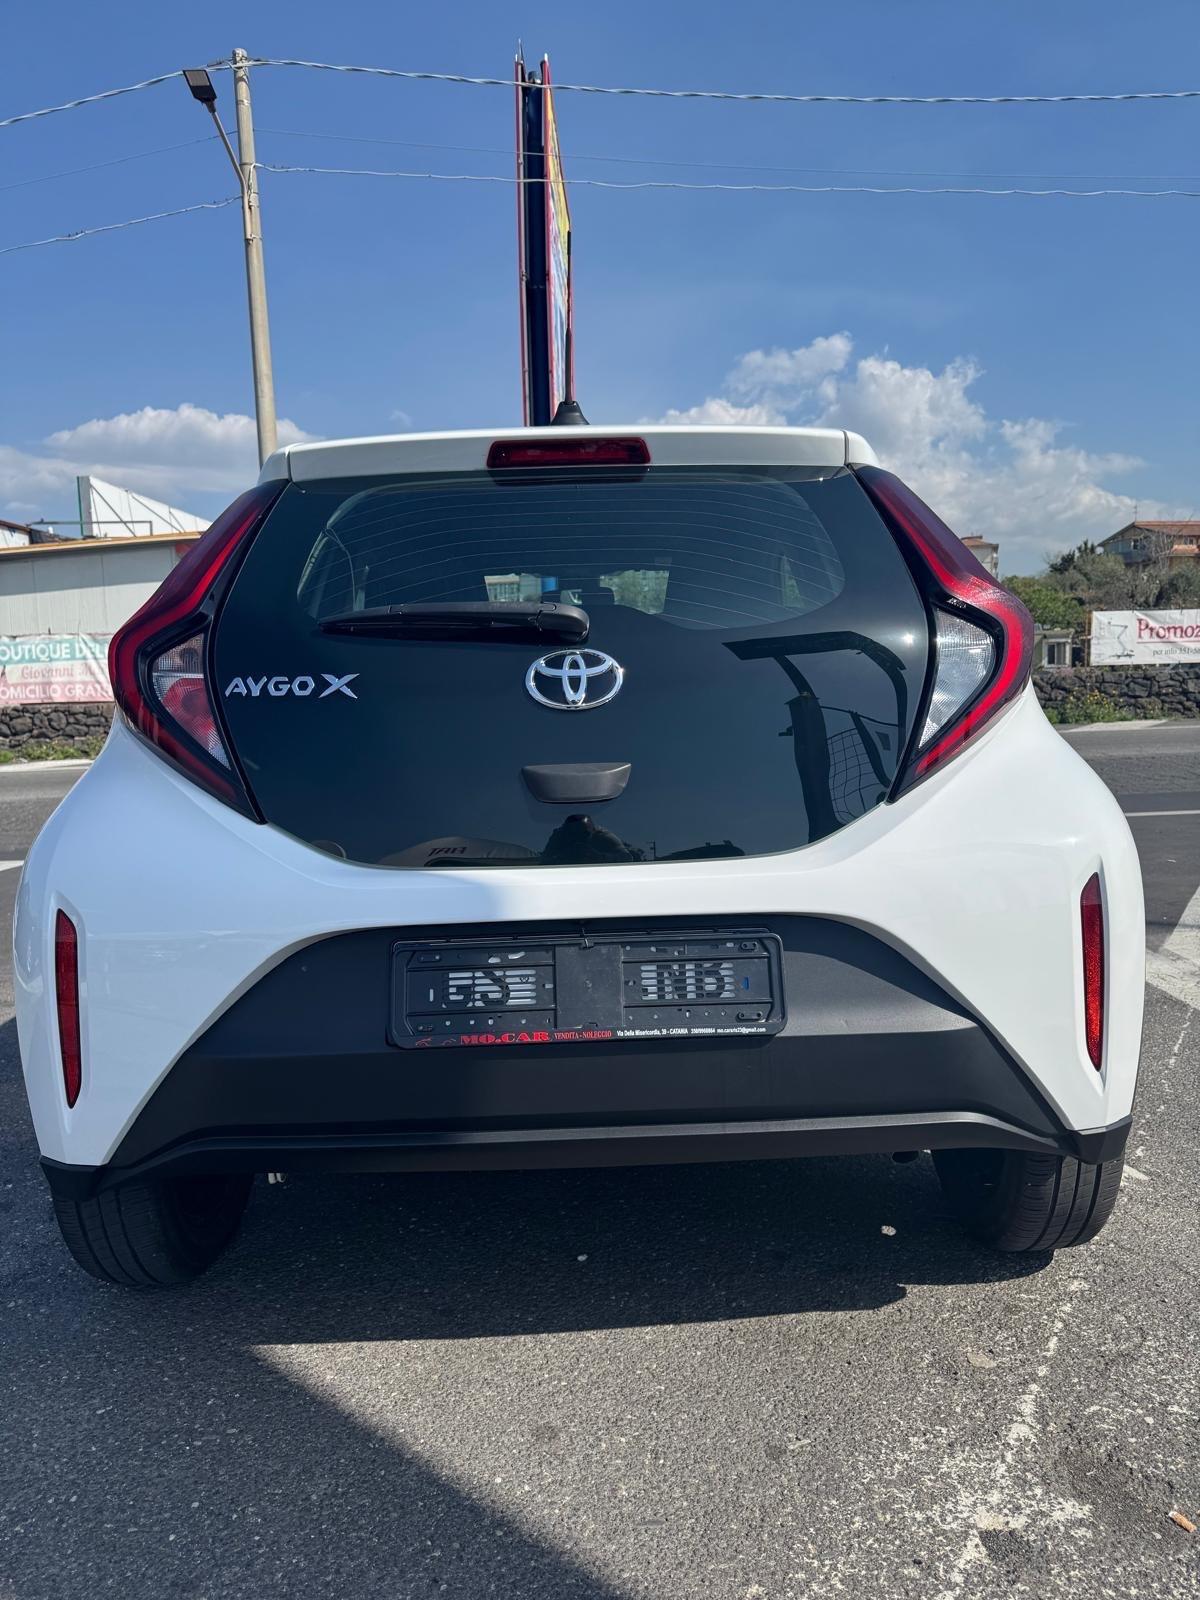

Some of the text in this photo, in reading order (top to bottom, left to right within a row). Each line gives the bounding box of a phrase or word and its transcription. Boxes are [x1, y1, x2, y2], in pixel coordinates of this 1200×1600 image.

[224, 673, 360, 699] AYGO X
[460, 1031, 550, 1045] MO.CAR
